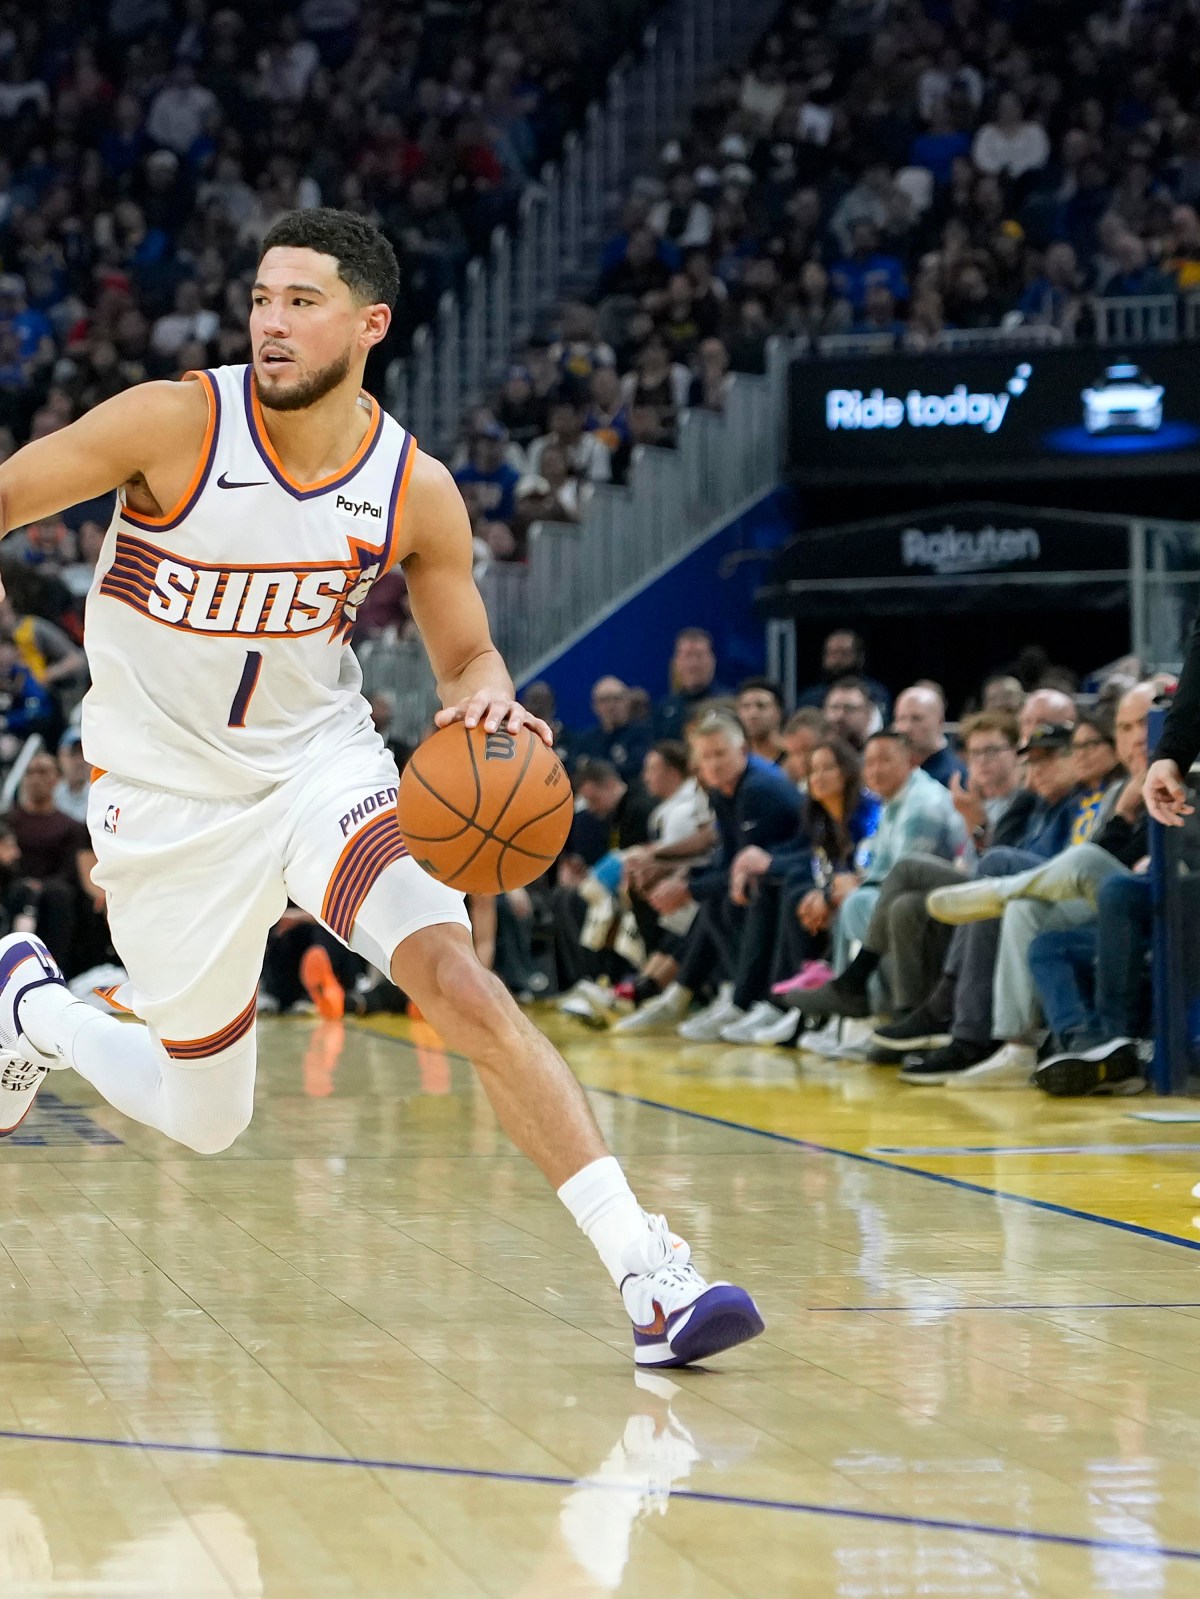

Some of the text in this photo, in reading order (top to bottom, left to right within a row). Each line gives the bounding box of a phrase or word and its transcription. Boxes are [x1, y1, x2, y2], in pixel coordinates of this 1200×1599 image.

[825, 384, 1010, 434] Ride today
[336, 494, 382, 519] PayPal
[902, 525, 1041, 567] Rakuten
[148, 558, 348, 634] SUNS
[227, 650, 264, 728] 1
[338, 786, 398, 838] PHOEN
